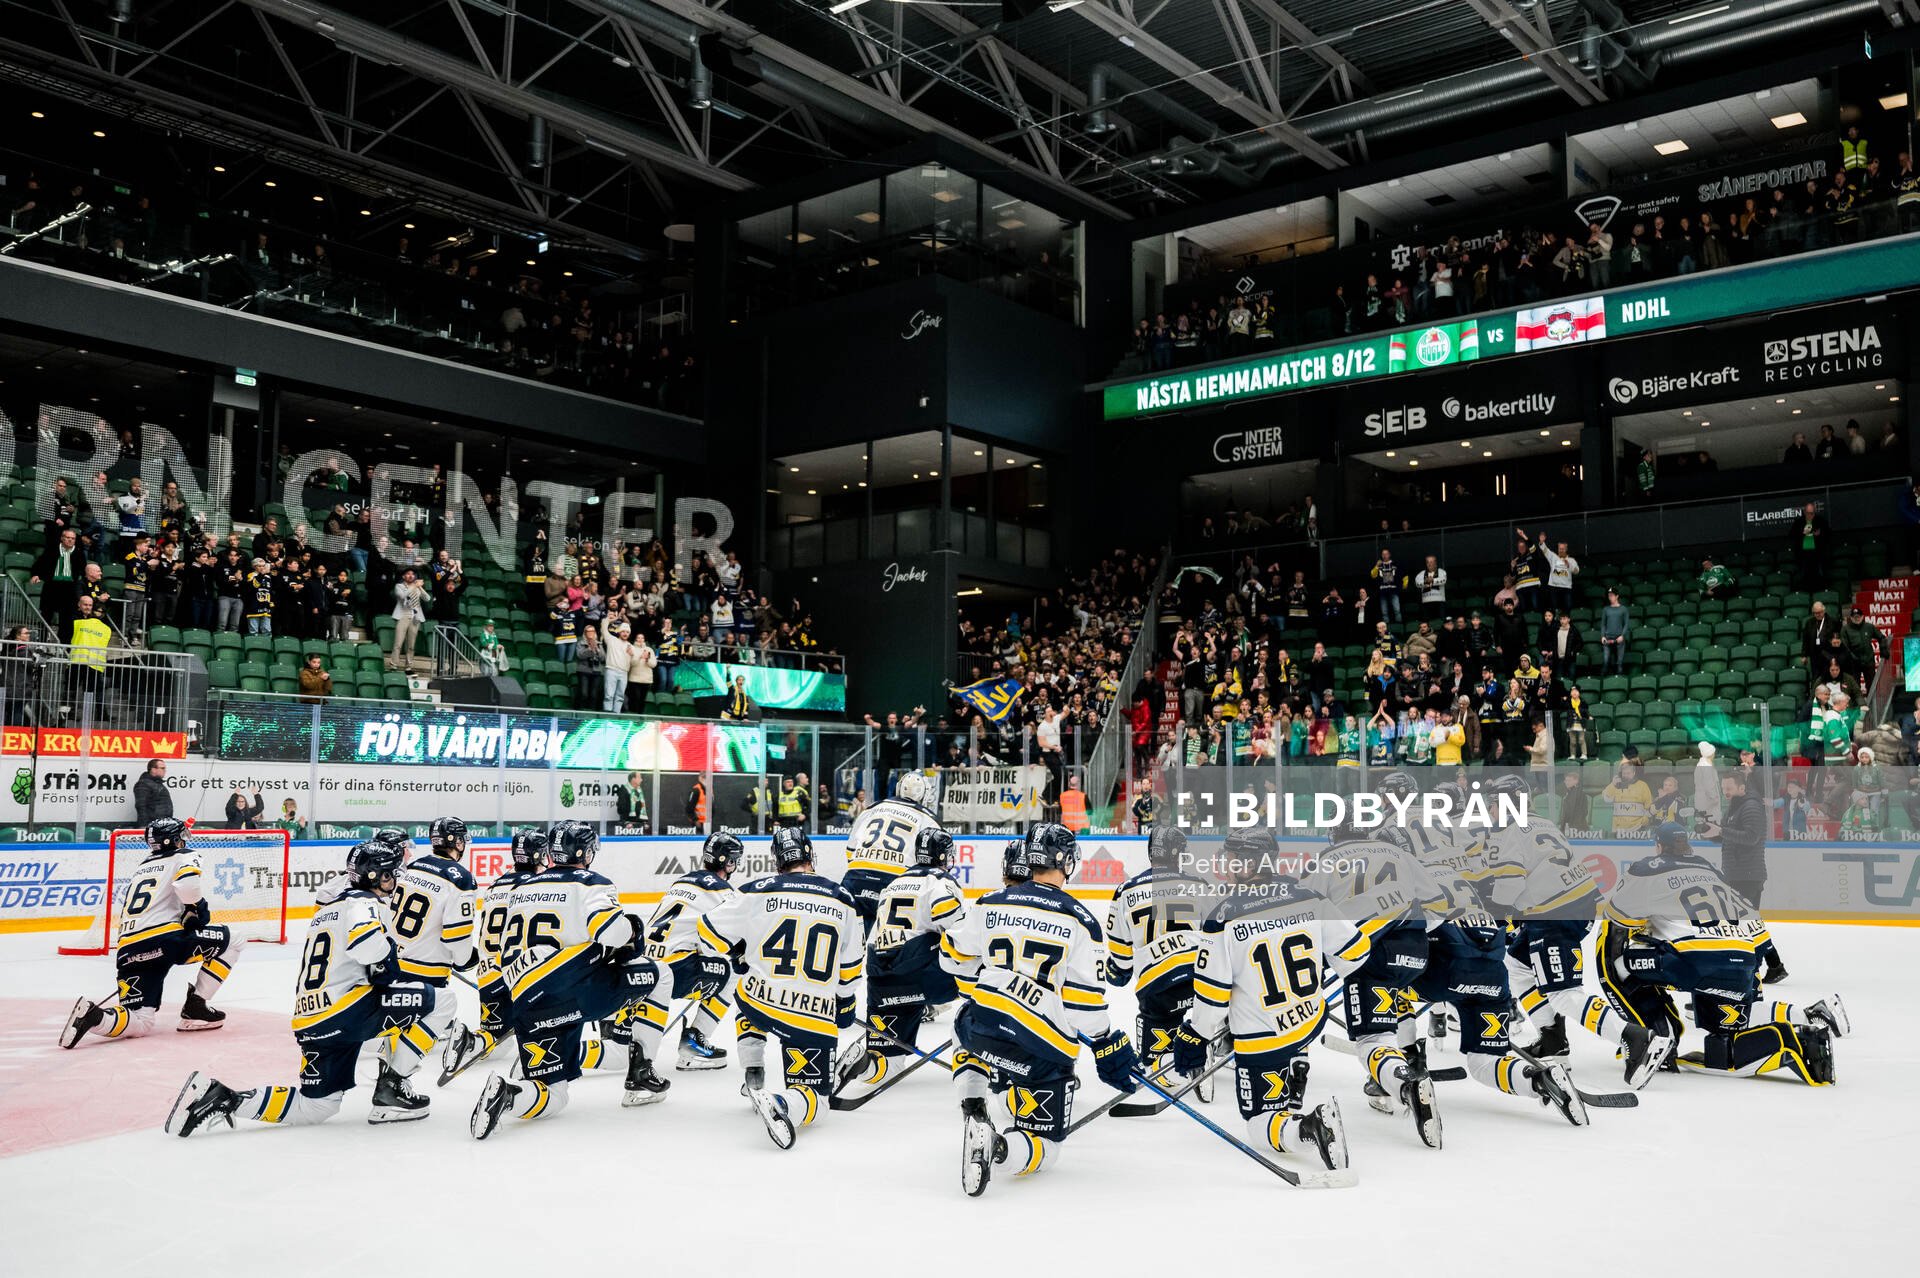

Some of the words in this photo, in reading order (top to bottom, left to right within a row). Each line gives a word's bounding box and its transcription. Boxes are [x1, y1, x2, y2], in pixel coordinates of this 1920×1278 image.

[1699, 160, 1826, 203] SKÅNEPORTAR
[1622, 297, 1671, 323] NDHL
[1790, 325, 1882, 361] STENA
[1765, 353, 1883, 383] RECYCLING
[1136, 380, 1192, 411] NÄSTA
[1195, 356, 1326, 401] HEMMAMATCH
[1332, 348, 1376, 378] 8/12
[1642, 376, 1688, 399] Bjäre
[1690, 366, 1740, 388] Kraft
[1364, 407, 1428, 437] SEB
[1244, 427, 1282, 446] INTER
[1232, 441, 1283, 462] SYSTEM
[0, 402, 233, 539] RN
[283, 449, 734, 585] CENTER
[1878, 579, 1909, 590] MAXI
[1873, 590, 1904, 601] MAXI
[1869, 602, 1900, 613] MAXI
[1864, 614, 1896, 626] MAXI
[43, 733, 142, 754] KRONAN
[359, 713, 421, 757] FÖR
[427, 715, 501, 759] VÅRT
[508, 727, 568, 762] RBK
[167, 775, 195, 790] Gör
[201, 776, 223, 790] ett
[229, 776, 288, 793] schysst
[319, 778, 342, 791] för
[344, 777, 374, 792] dina
[376, 778, 463, 793] fönsterrutor
[465, 780, 488, 793] och
[993, 770, 1017, 785] RIKE
[948, 790, 970, 804] RUN
[977, 789, 996, 804] FÖR
[16, 829, 60, 842] Boozt
[328, 827, 361, 839] Boozt
[614, 825, 644, 835] Boozt
[667, 825, 697, 835] Boozt
[719, 825, 750, 835] Boozt
[862, 818, 913, 853] 35
[985, 825, 1014, 835] Boozt
[1089, 825, 1119, 835] Boozt
[1192, 826, 1220, 835] Boozt
[1290, 826, 1318, 836] Boozt
[1568, 828, 1603, 840] Boozt
[515, 892, 567, 905] Husqvarna
[778, 897, 843, 920] Husqvarna
[996, 913, 1071, 938] Husqvarna
[1131, 904, 1195, 945] 75
[1248, 909, 1315, 935] Husqvarna
[195, 929, 224, 941] LEBA
[501, 912, 564, 965] 26
[761, 918, 839, 983] 40
[506, 949, 539, 985] TIKKA
[701, 961, 726, 975] LEBA
[988, 937, 1065, 991] 27
[1252, 932, 1319, 1007] 16
[1547, 946, 1565, 983] LEBA
[1628, 956, 1656, 970] LEBA
[626, 972, 655, 986] LEBA
[381, 993, 423, 1007] LEBA
[1350, 983, 1363, 1026] LEBA
[529, 1063, 564, 1078] AXELENT
[786, 1077, 823, 1085] AXELENT
[1238, 1067, 1253, 1111] LEBA
[1261, 1100, 1290, 1111] AXEL
